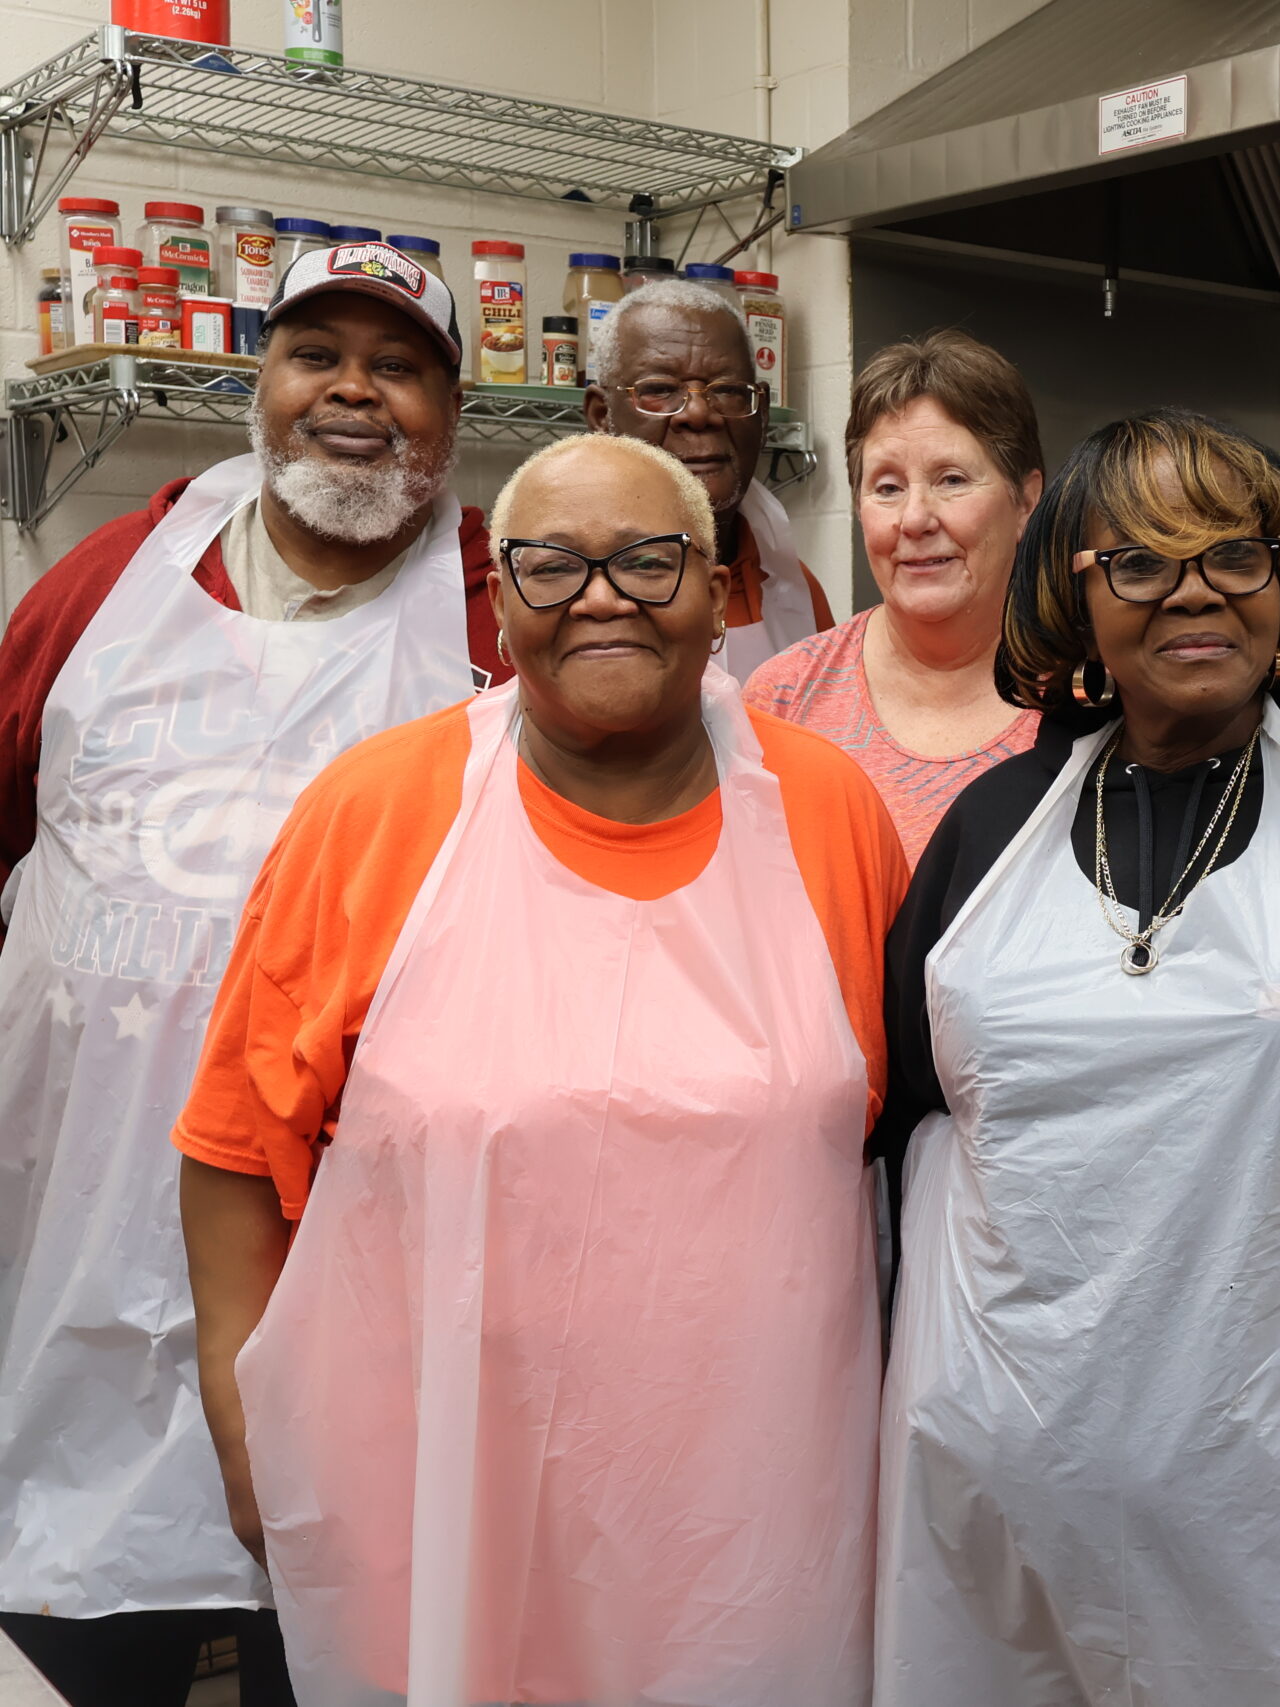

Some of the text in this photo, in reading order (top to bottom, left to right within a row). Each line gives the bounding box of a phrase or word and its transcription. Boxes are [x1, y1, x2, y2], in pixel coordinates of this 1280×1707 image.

[171, 5, 201, 20] (2.26kg)
[1125, 88, 1159, 105] CAUTION
[1113, 96, 1171, 116] EXHAUST FAN MUST BE
[1117, 104, 1167, 123] TURNED ON BEFORE
[1103, 107, 1184, 134] LIGHTING COOKING APPLIANCES
[162, 251, 205, 262] McCormick
[243, 244, 272, 256] Tone's
[332, 247, 421, 291] BLACKHAWKS
[483, 307, 521, 318] CHILI
